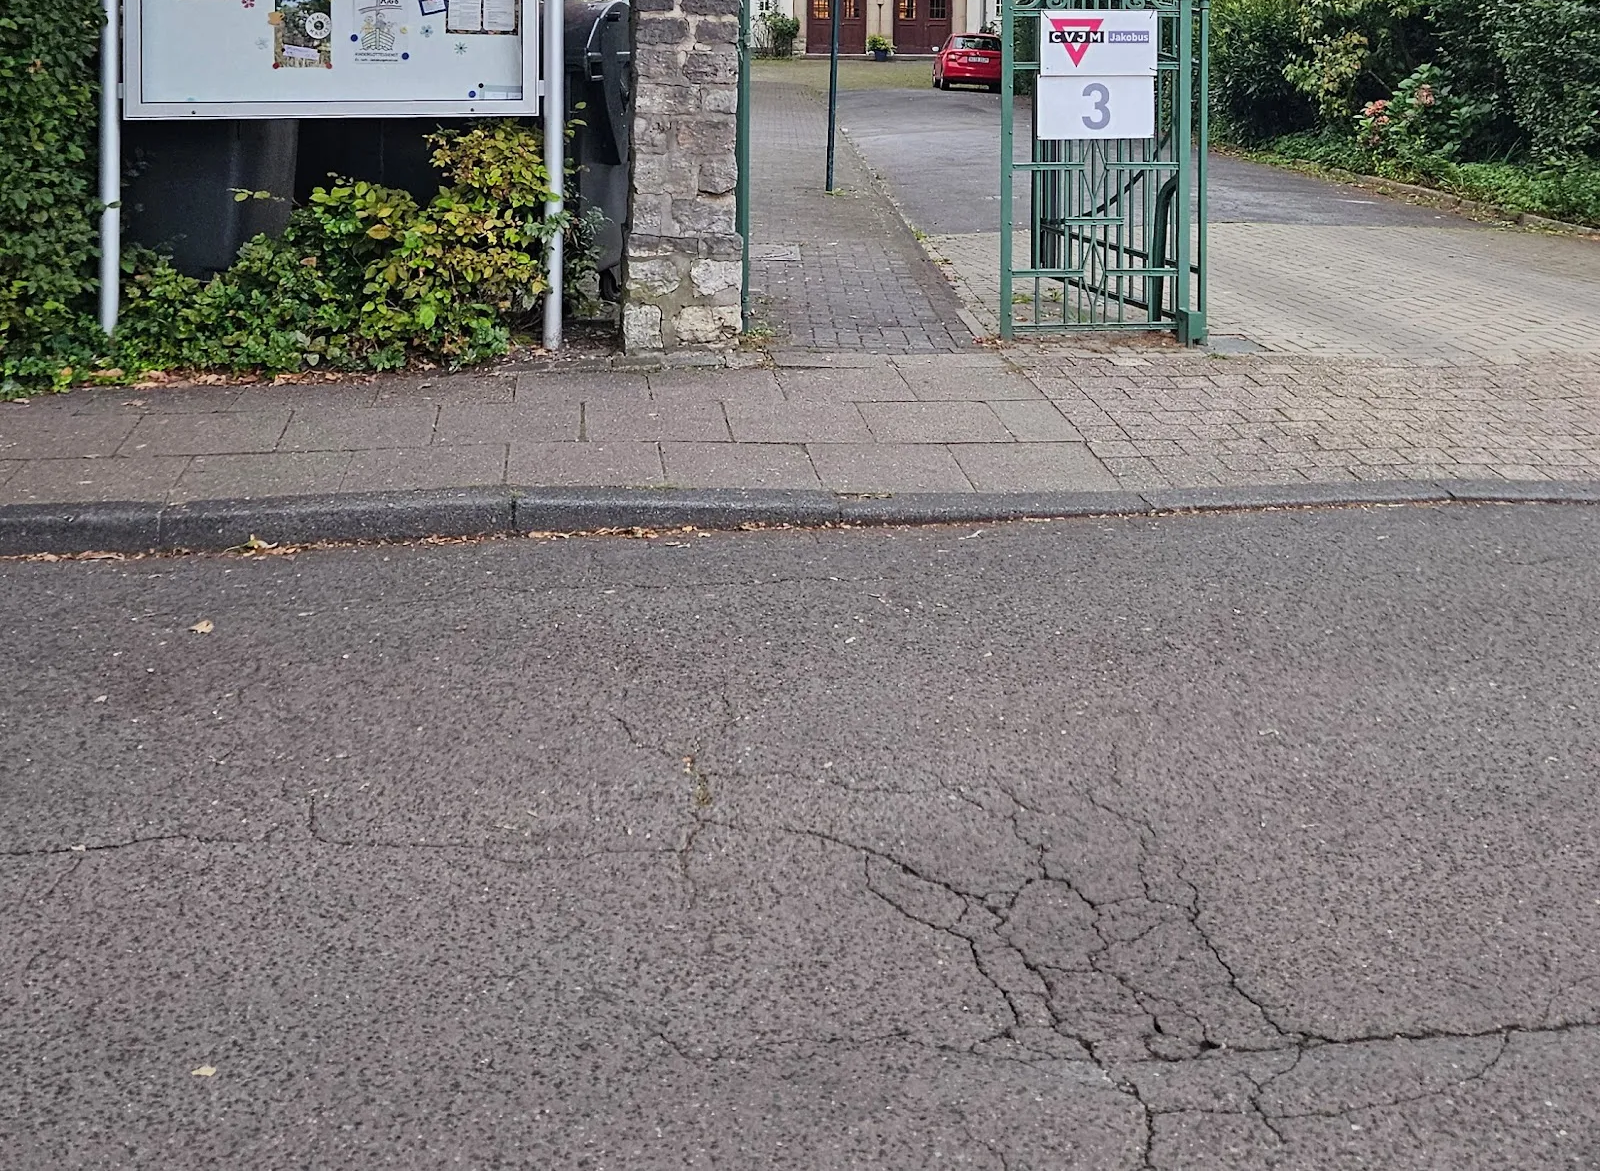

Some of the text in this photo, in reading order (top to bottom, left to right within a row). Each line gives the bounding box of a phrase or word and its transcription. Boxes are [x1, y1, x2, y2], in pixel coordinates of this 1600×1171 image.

[1051, 31, 1149, 43] CVJM Jakobus
[1082, 83, 1111, 130] 3
